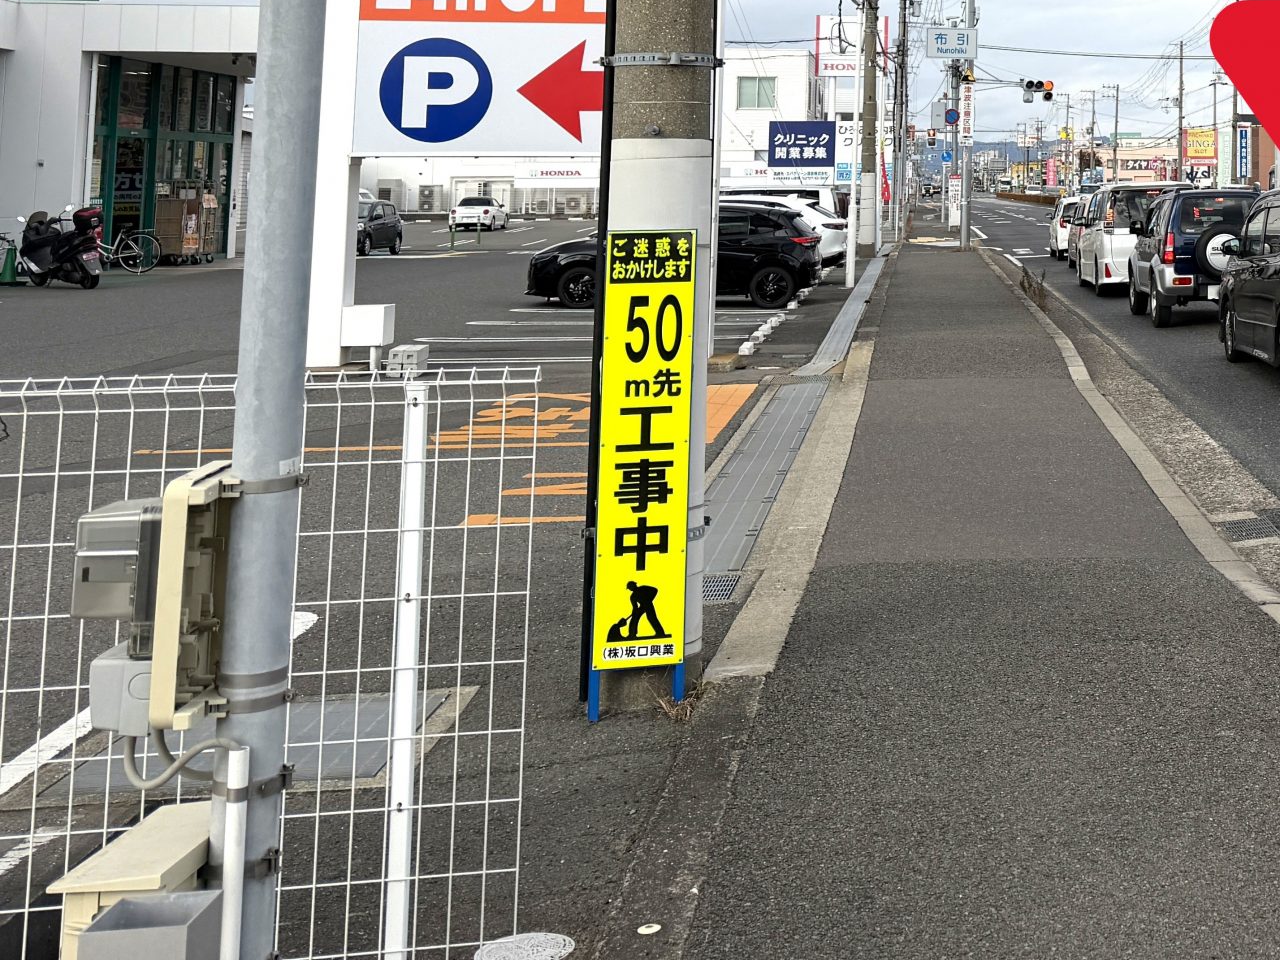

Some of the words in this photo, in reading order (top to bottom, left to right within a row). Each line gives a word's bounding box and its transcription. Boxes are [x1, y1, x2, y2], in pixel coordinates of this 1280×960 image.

[934, 32, 969, 45] 布引
[936, 46, 967, 54] Nunohiki
[963, 86, 973, 135] 津波注意区間
[774, 133, 830, 146] クリニック
[1184, 139, 1216, 148] GINGA
[774, 146, 828, 159] 開業募集
[612, 236, 690, 258] ご迷惑を
[611, 258, 691, 280] おかけします
[624, 294, 683, 364] 50
[624, 368, 682, 399] m先
[613, 405, 675, 572] 工事中
[602, 643, 675, 659] (株)坂口興業
